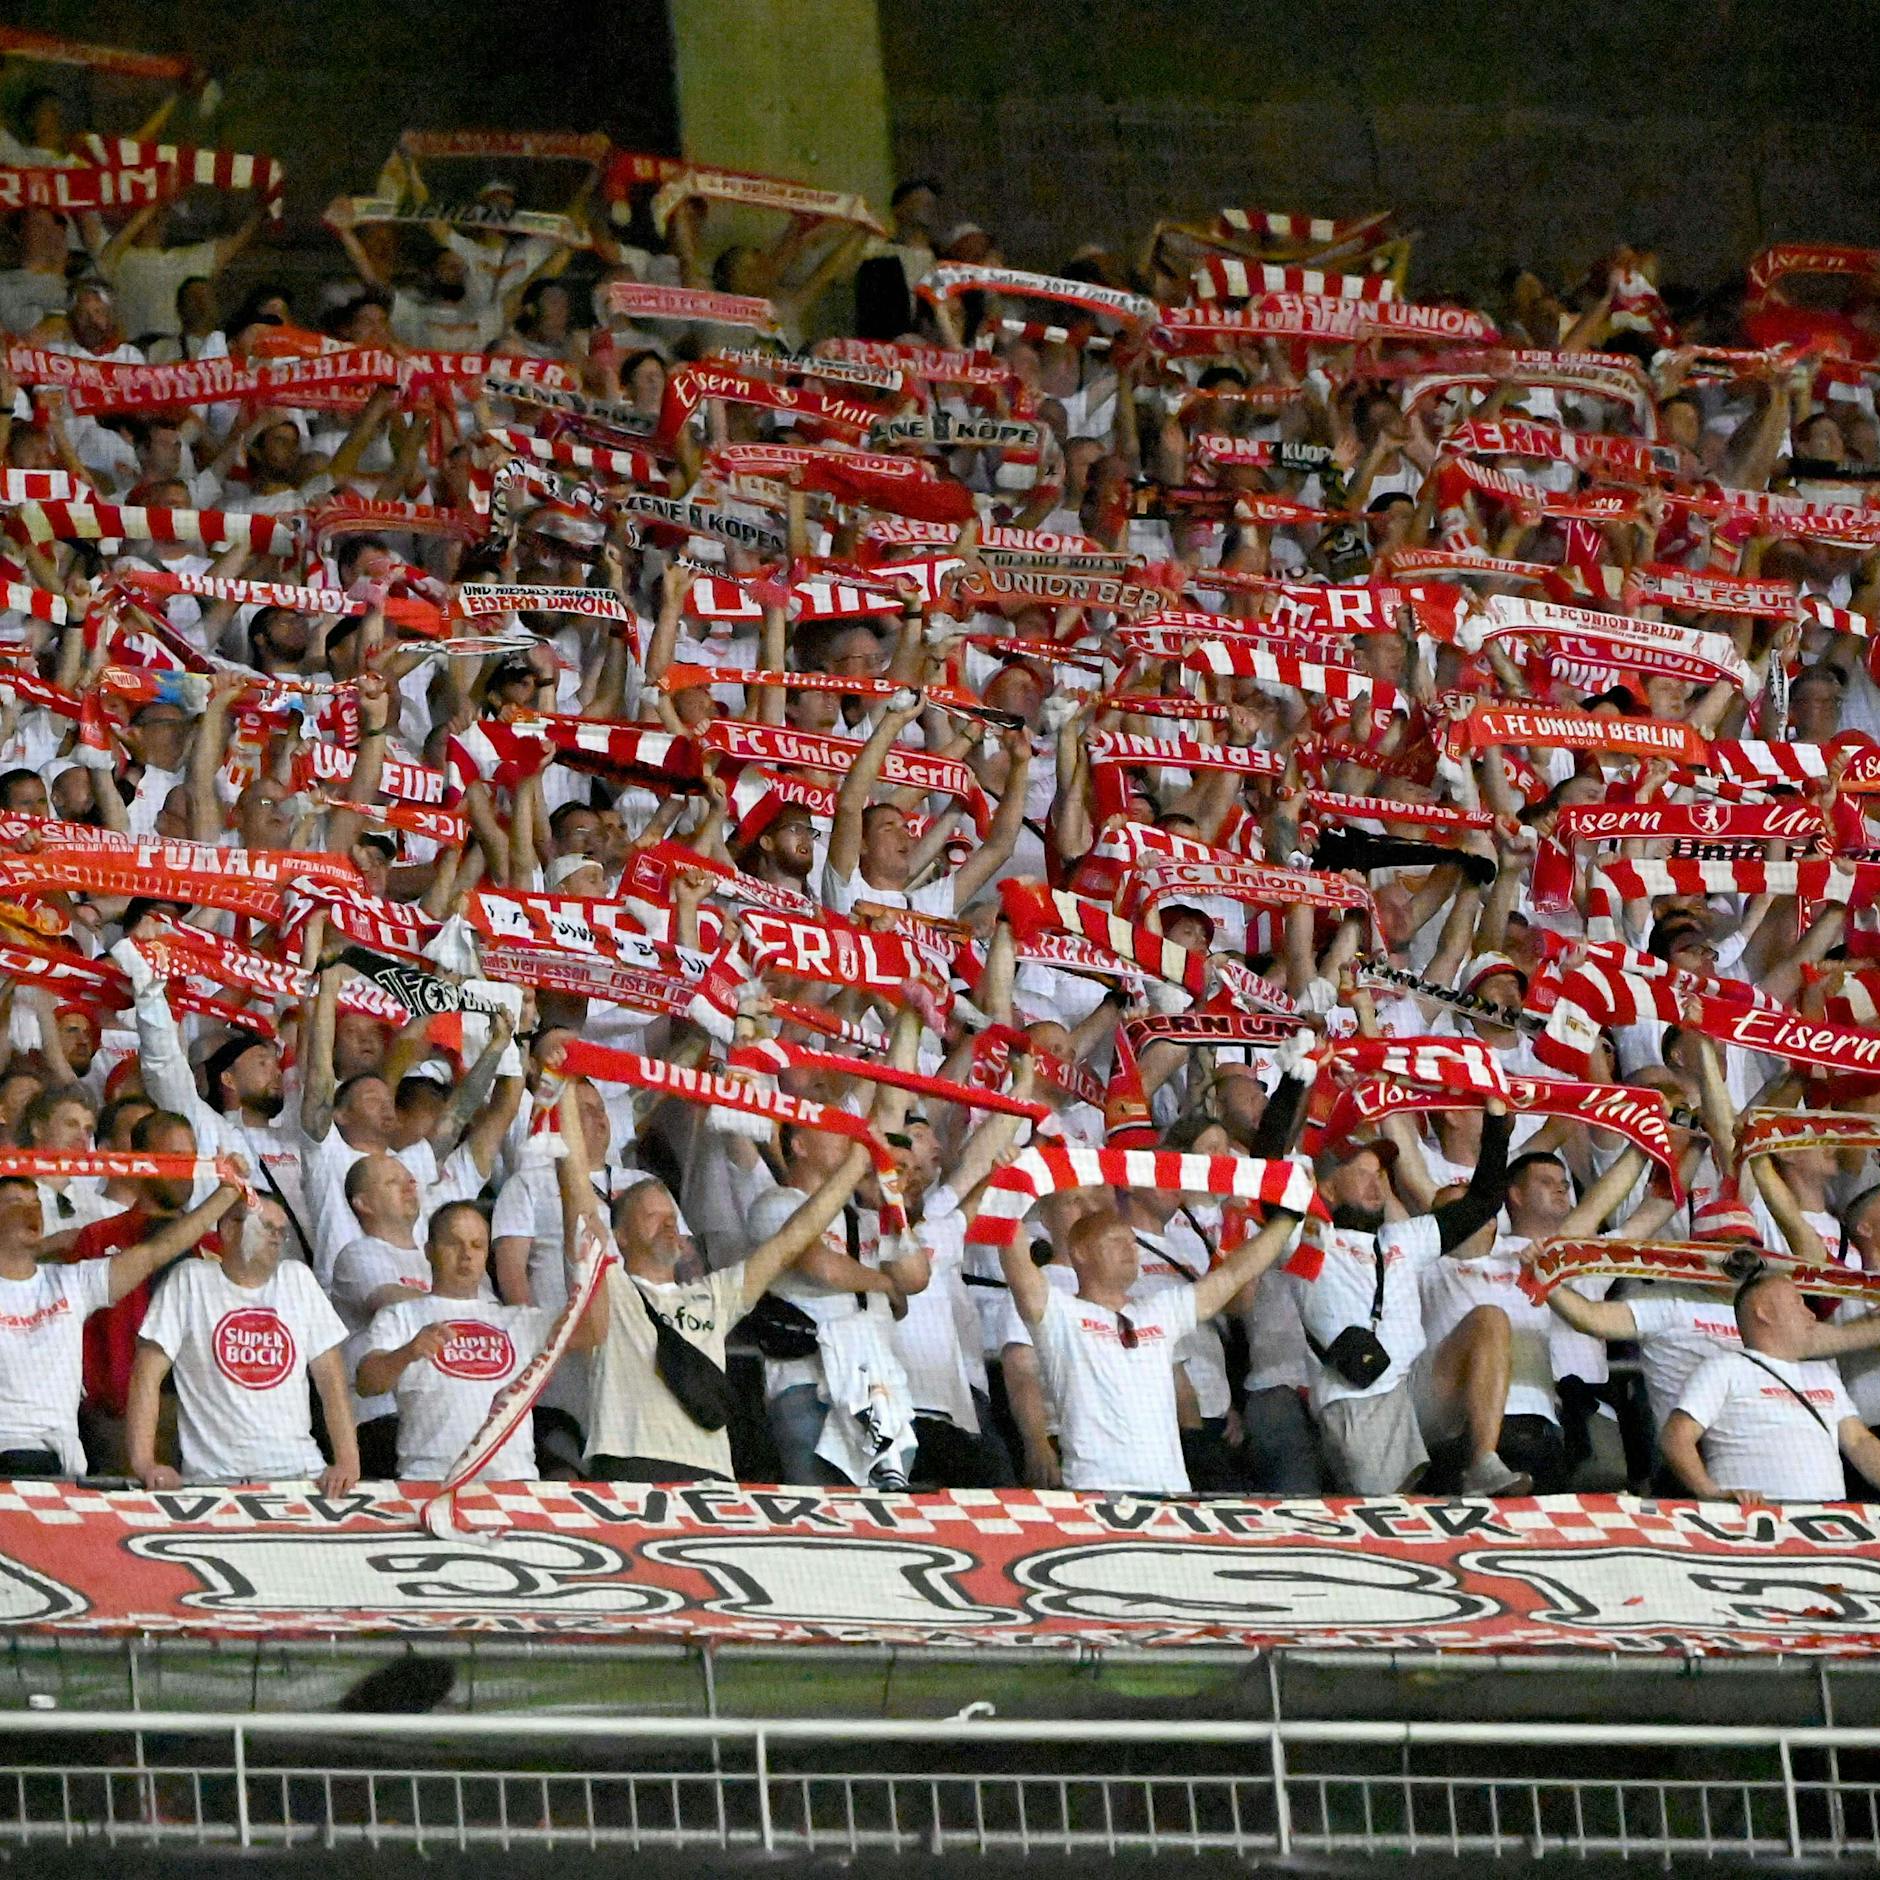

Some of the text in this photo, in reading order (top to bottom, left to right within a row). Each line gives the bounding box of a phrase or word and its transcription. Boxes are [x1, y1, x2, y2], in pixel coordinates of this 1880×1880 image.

[1388, 302, 1484, 338] UNION
[980, 520, 1086, 554] UNION
[463, 585, 491, 597] UND
[990, 570, 1090, 601] UNION
[1711, 588, 1751, 606] FC
[466, 596, 540, 614] EISERN
[1559, 607, 1578, 621] FC
[1580, 608, 1630, 632] UNION
[1632, 617, 1686, 641] BERLIN
[1482, 713, 1686, 751] 1. FC UNION BERLIN
[725, 725, 769, 755] FC
[773, 732, 858, 768] Unio
[1569, 809, 1664, 834] isern
[1157, 865, 1201, 885] FC
[1214, 866, 1308, 892] Union
[1730, 1007, 1880, 1065] Eisern
[224, 1326, 284, 1350] SUPER
[225, 1345, 284, 1367] BOCK
[443, 1346, 504, 1364] BOCK
